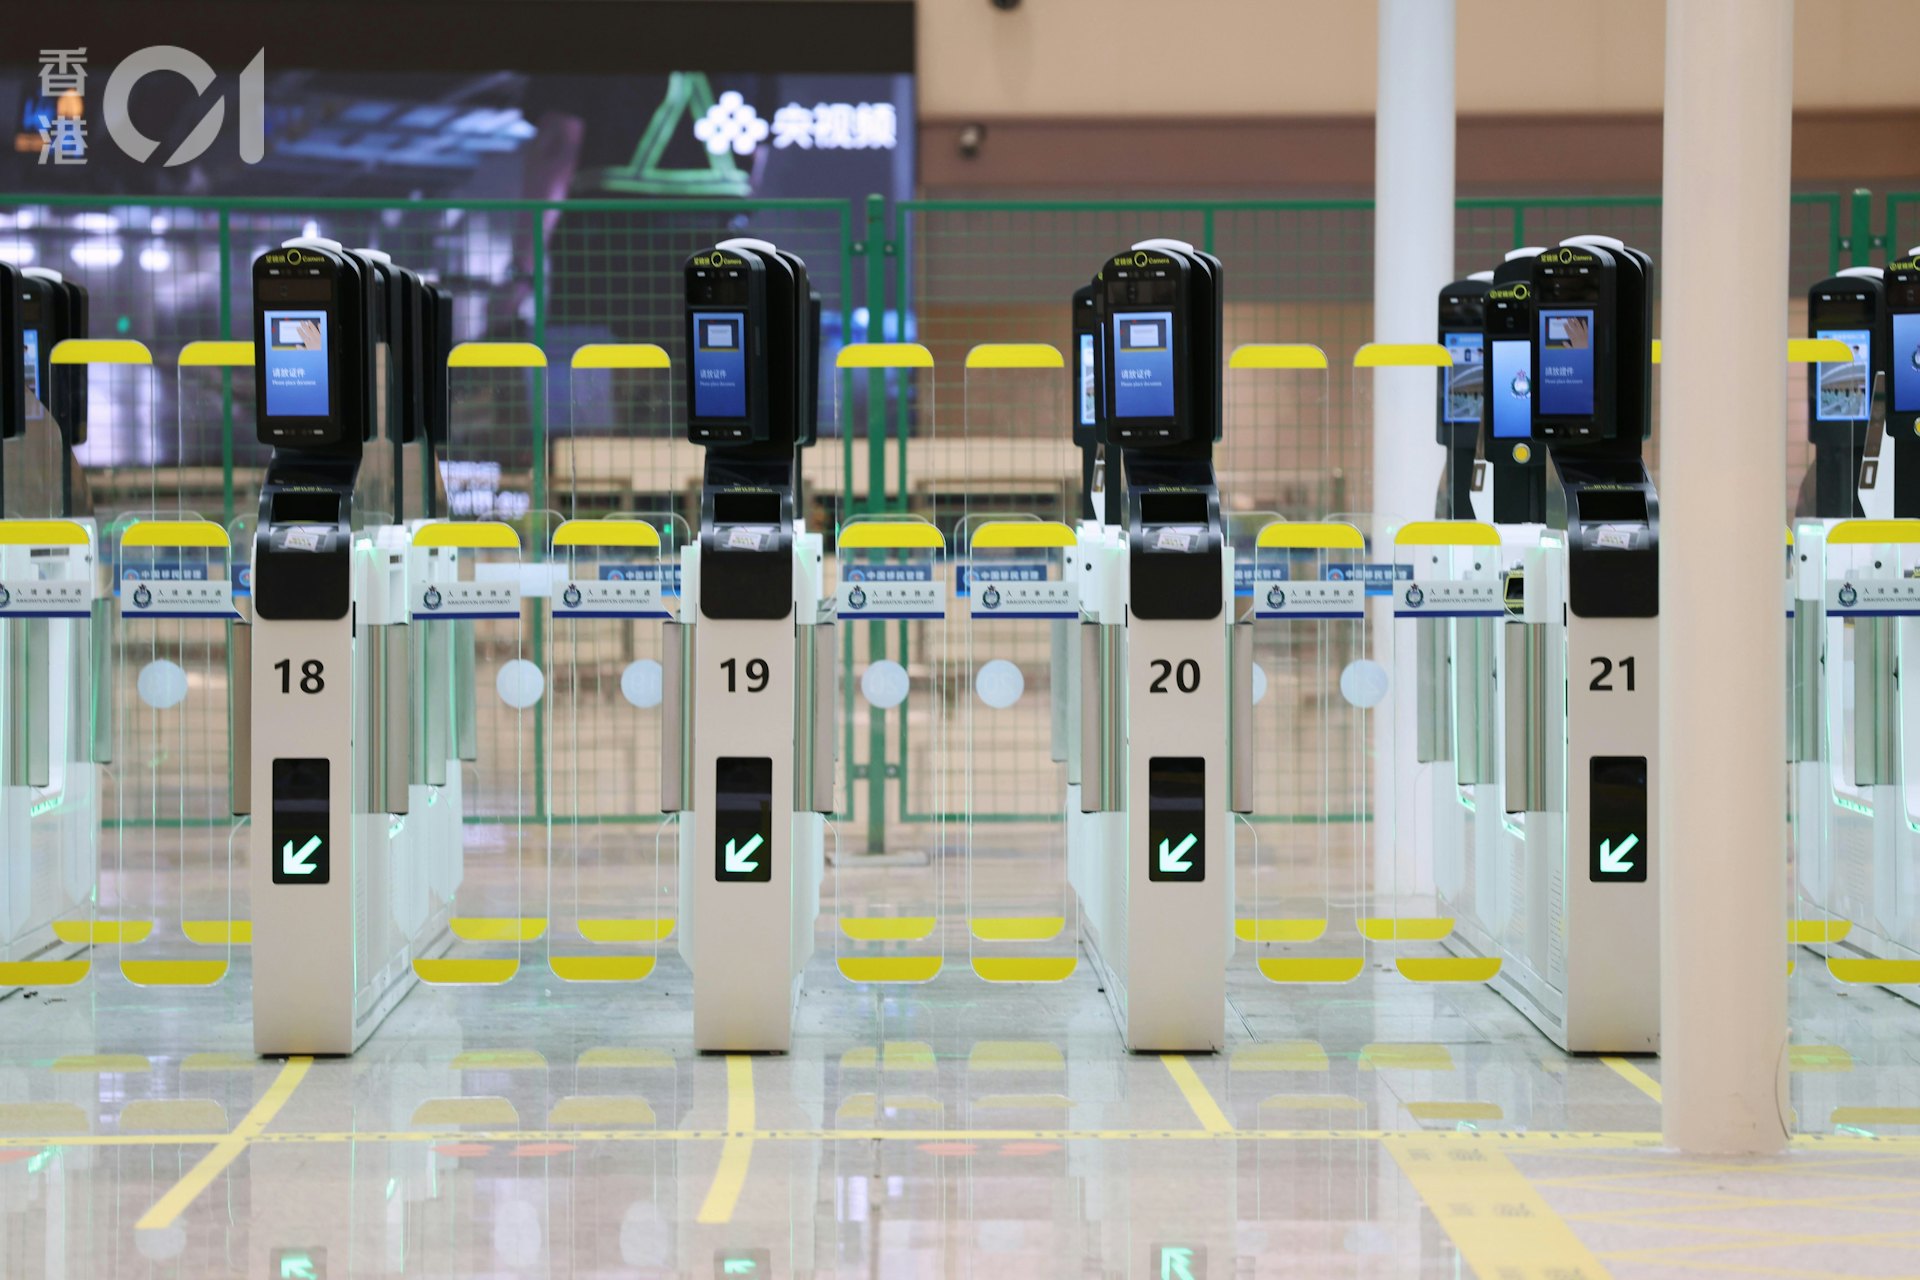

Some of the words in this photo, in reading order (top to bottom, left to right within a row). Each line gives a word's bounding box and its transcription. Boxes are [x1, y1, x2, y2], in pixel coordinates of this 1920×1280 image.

[771, 102, 897, 149] 央视频
[275, 659, 324, 694] 18
[721, 658, 769, 692] 19
[1150, 659, 1200, 693] 20
[1590, 657, 1634, 691] 21
